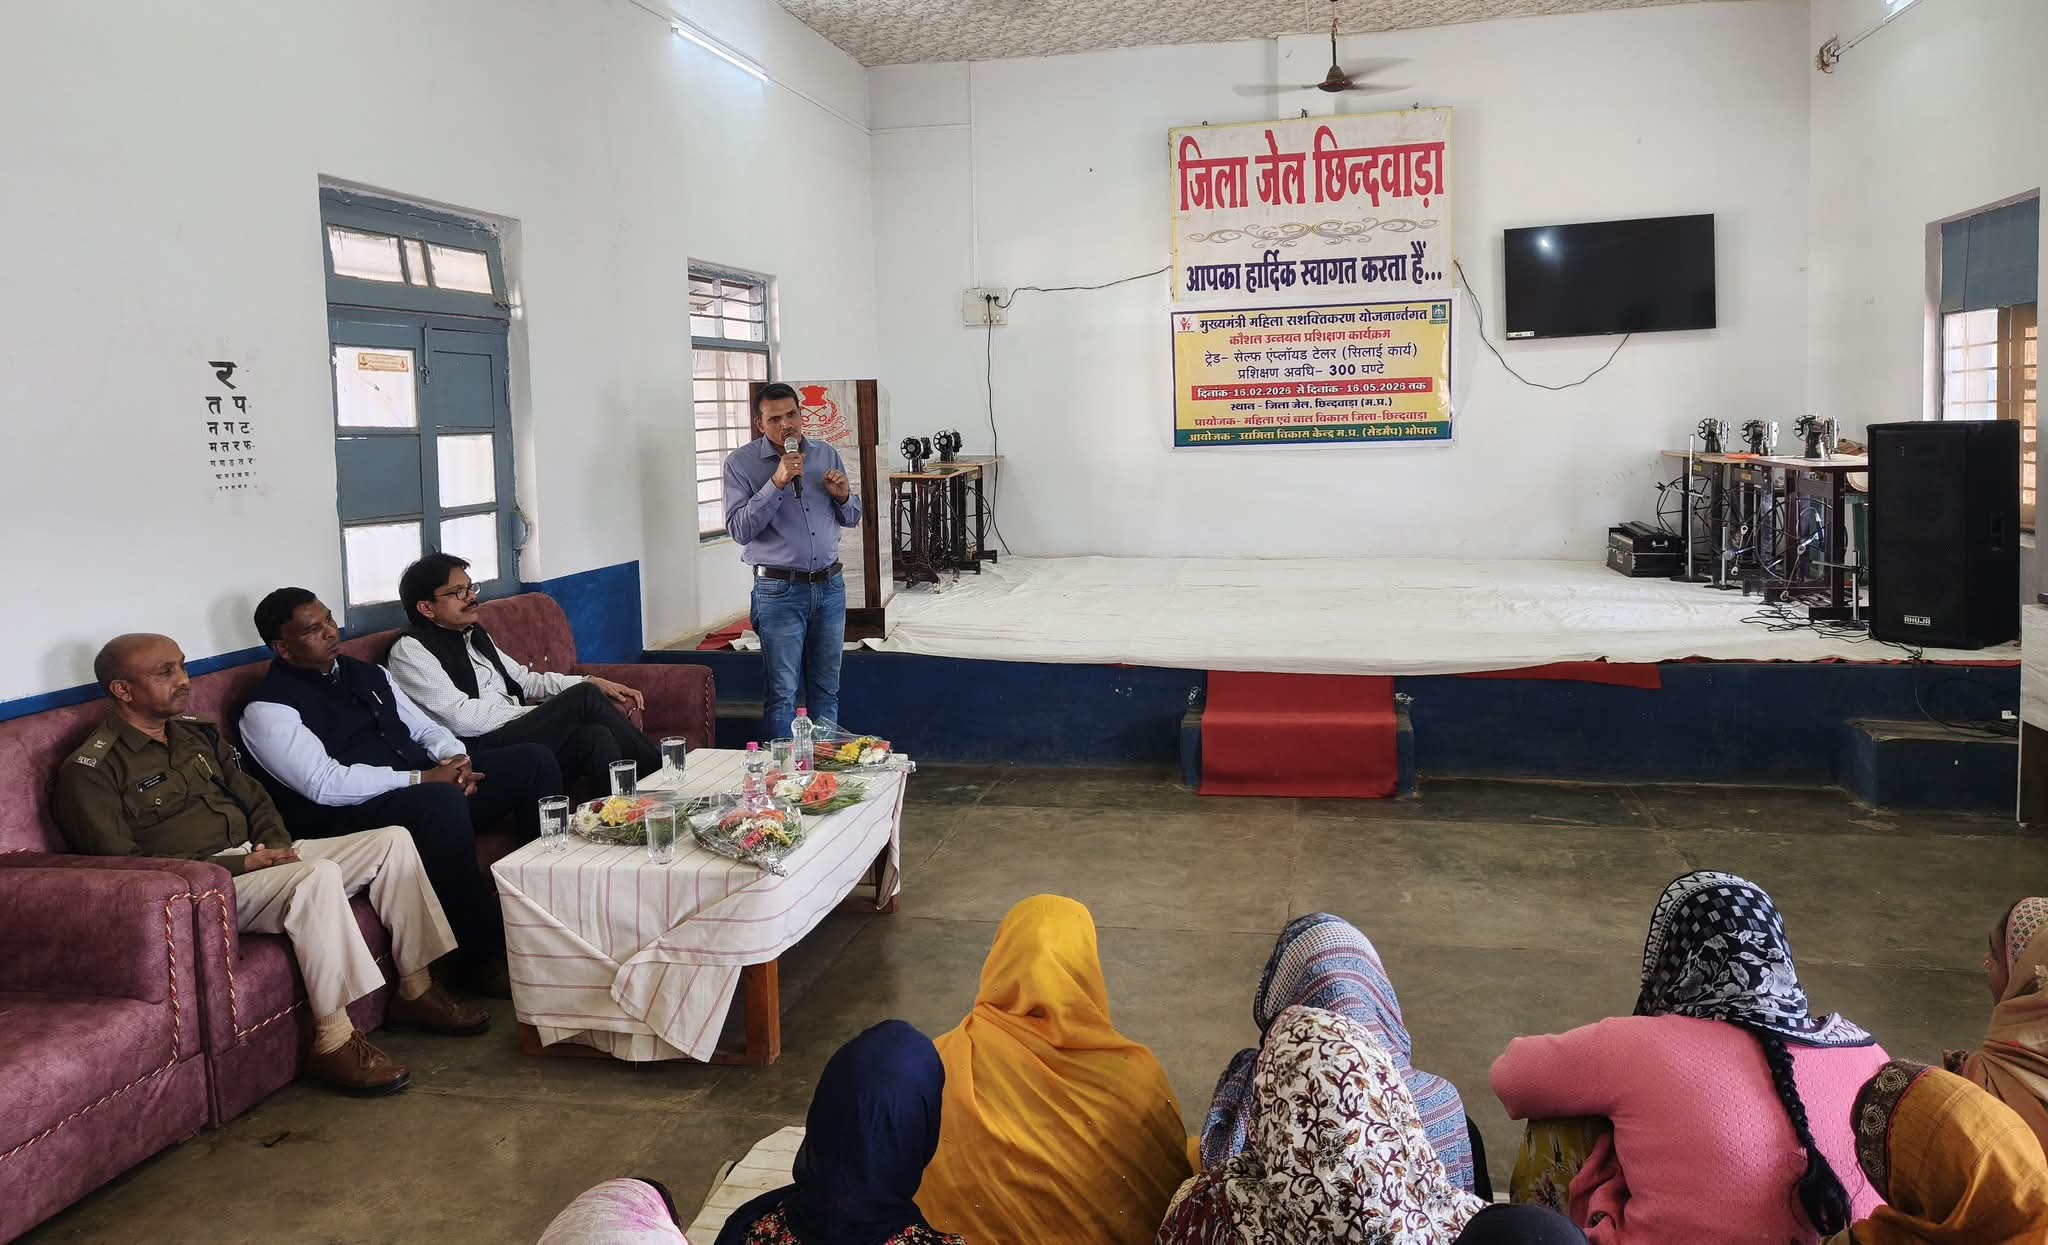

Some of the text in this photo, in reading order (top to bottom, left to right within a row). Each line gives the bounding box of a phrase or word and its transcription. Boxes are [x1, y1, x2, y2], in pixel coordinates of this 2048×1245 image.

[1178, 125, 1445, 211] जिला जेल छिन्दवाड़ा
[1186, 263, 1241, 292] आपका
[1244, 249, 1297, 294] हार्दिक
[1300, 257, 1357, 286] स्वागत
[1361, 254, 1408, 284] करता
[1200, 314, 1246, 334] मुख्यमंत्री
[1249, 313, 1283, 328] महिला
[1286, 310, 1356, 327] सशक्तिकरण
[1229, 326, 1391, 345] कौशल उन्नयन प्रशिक्षण कार्यक्रम
[1234, 349, 1262, 363] सेल्फ
[1265, 347, 1308, 363] एंप्लॉयड
[1312, 345, 1337, 360] टेलर
[1342, 343, 1383, 360] (सिलाई
[1388, 341, 1418, 357] कार्य)
[208, 361, 238, 390] र
[1237, 365, 1279, 379] प्रशिक्षण
[1329, 364, 1356, 376] 300
[1361, 360, 1385, 374] घण्टे
[1296, 384, 1305, 394] से
[1347, 382, 1406, 392] 16.05.2026
[1408, 381, 1427, 391] तक
[1231, 402, 1255, 411] स्थान
[1265, 399, 1289, 410] जिला
[1360, 397, 1392, 407] (म.प्र.)
[1243, 414, 1274, 426] महिला
[1276, 413, 1290, 425] एवं
[1315, 411, 1349, 423] विकास
[1238, 429, 1275, 441] उद्यमिता
[1277, 428, 1310, 439] विकास
[1312, 427, 1334, 438] केन्द्र
[1405, 424, 1437, 435] भोपाल
